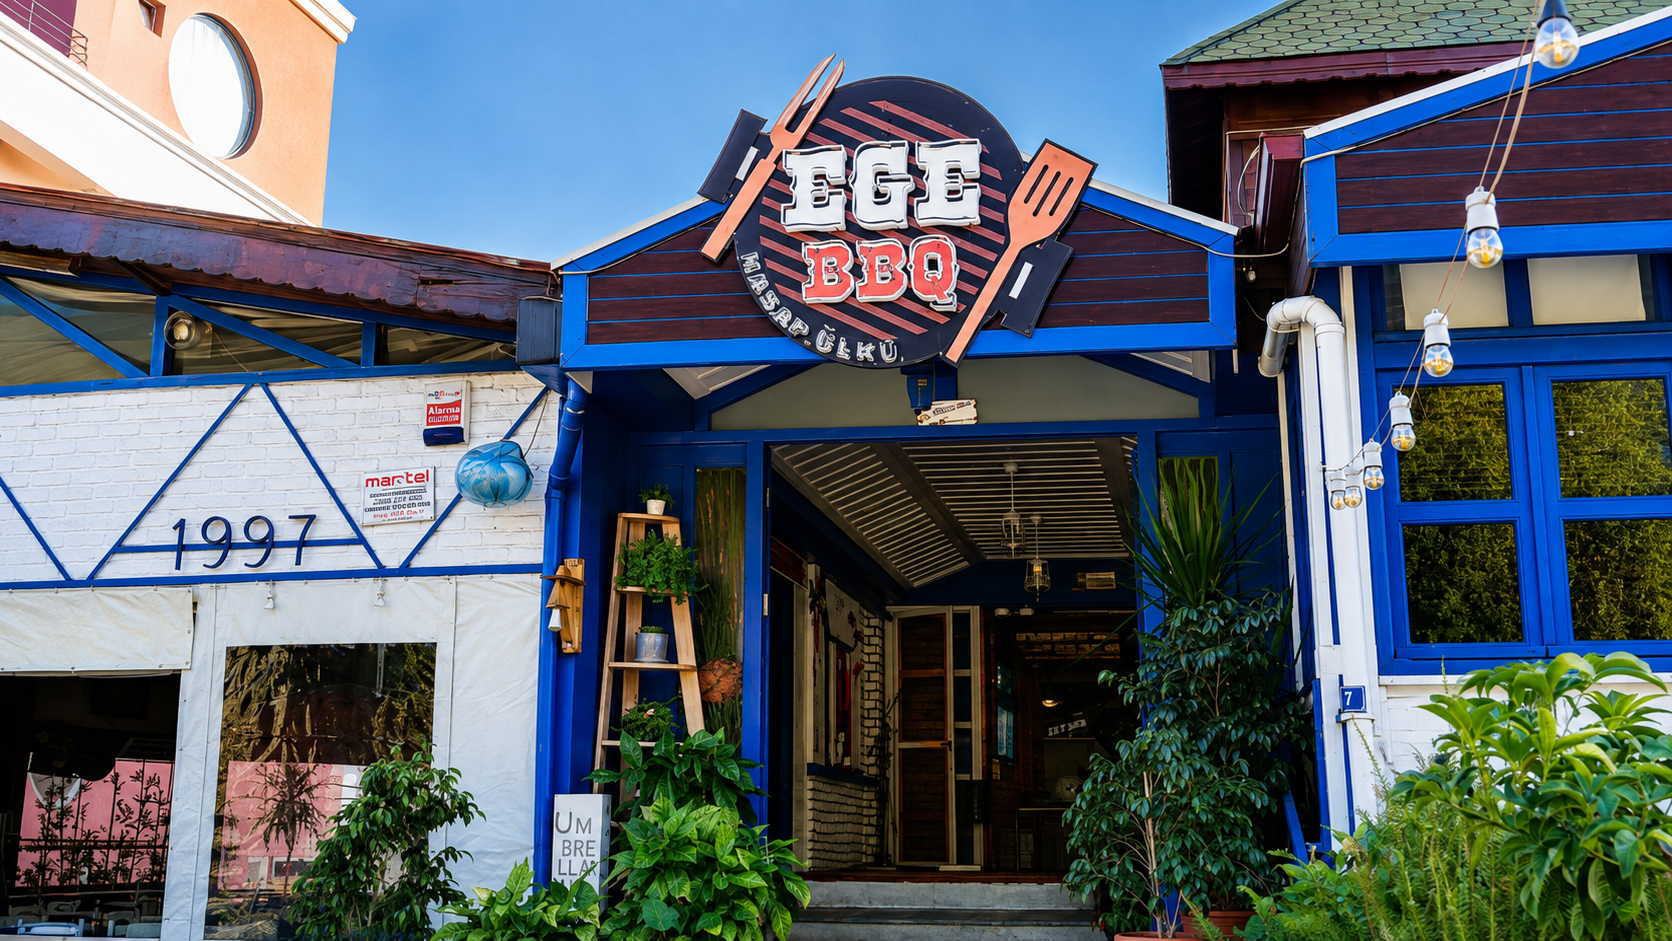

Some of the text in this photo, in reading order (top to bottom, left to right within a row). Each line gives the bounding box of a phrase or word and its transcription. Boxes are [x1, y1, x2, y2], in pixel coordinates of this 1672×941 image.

[781, 138, 982, 233] EGE
[801, 234, 960, 312] BBQ
[365, 469, 430, 488] martel
[172, 514, 317, 571] 1997
[1344, 691, 1353, 706] 7
[555, 811, 592, 835] UM
[562, 839, 596, 858] BRE
